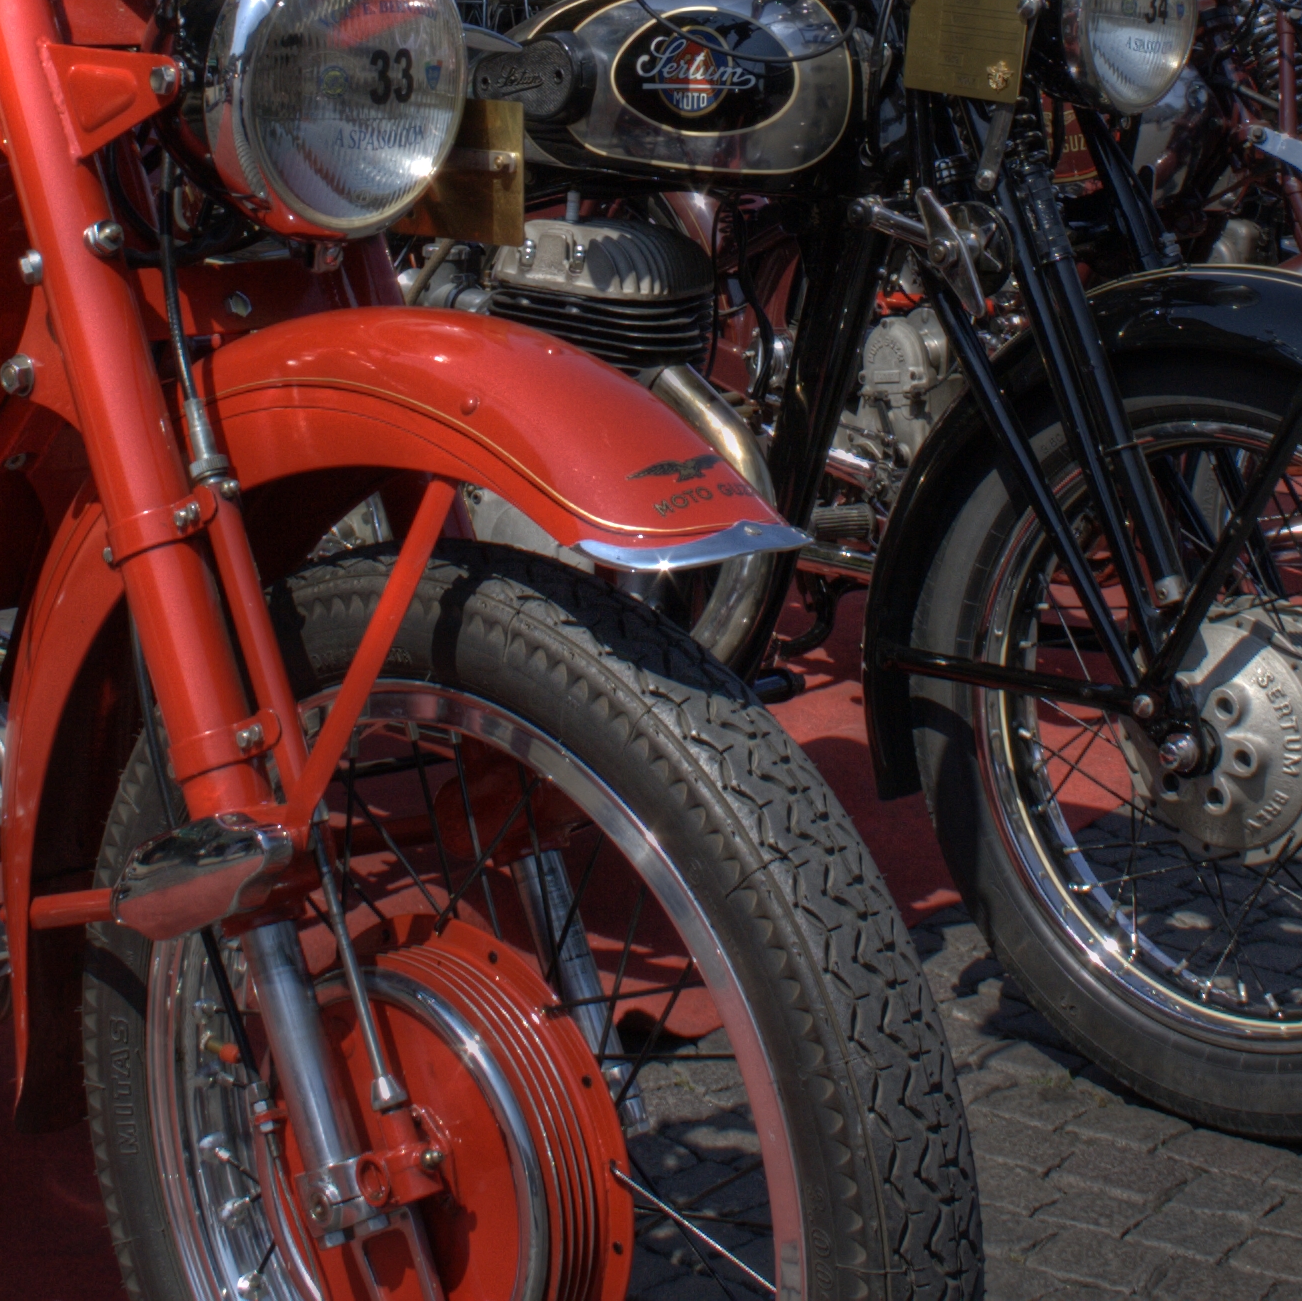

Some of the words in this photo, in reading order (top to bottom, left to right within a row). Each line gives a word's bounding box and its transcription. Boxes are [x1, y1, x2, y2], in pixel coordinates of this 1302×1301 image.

[369, 47, 414, 105] 33
[636, 35, 757, 90] Sertum
[673, 90, 708, 111] MOTO
[653, 486, 714, 518] MOTO
[717, 482, 756, 498] GUZ
[1256, 670, 1302, 777] SERTUM
[109, 1015, 139, 1154] MITAS
